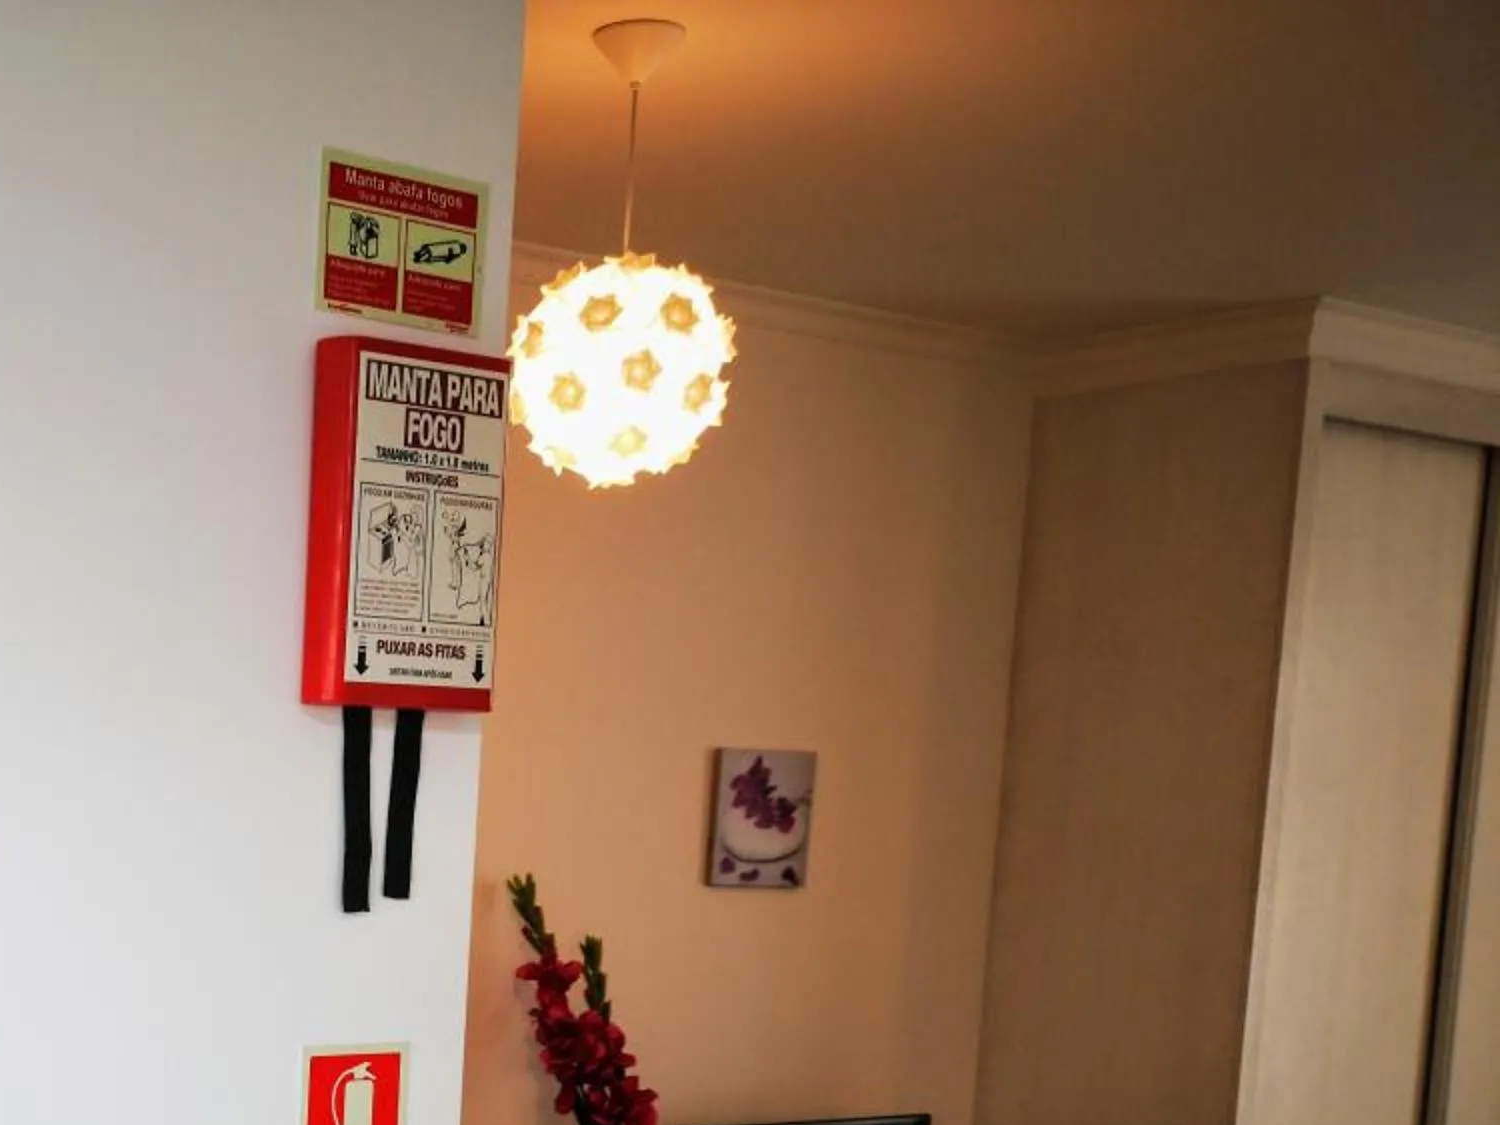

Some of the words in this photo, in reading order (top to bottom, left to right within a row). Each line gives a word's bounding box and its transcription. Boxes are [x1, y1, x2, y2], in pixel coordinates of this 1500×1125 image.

[345, 168, 385, 191] Manta
[368, 361, 443, 408] MANTA
[447, 374, 500, 416] PARA
[407, 411, 461, 450] FOGO
[377, 640, 417, 657] PUXAR
[417, 643, 433, 658] AS
[435, 644, 466, 660] FITAS
